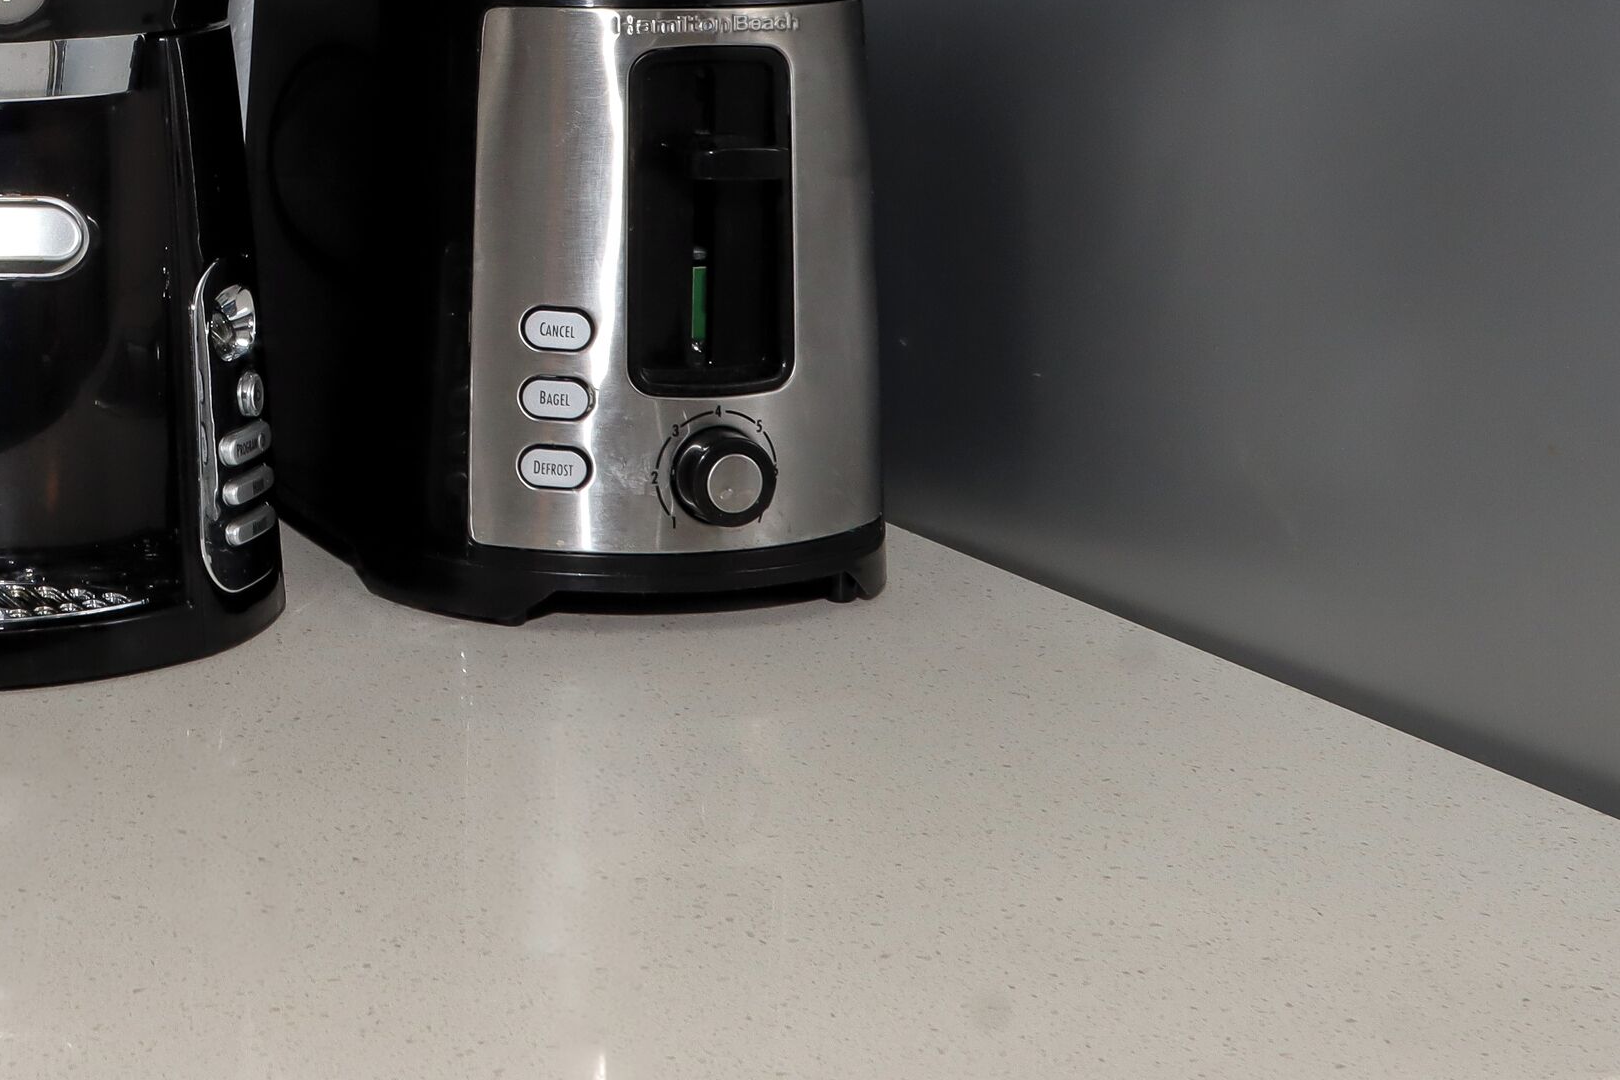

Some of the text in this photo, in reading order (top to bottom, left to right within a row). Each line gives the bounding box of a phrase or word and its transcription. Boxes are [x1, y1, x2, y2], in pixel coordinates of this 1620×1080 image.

[733, 13, 799, 32] Beach
[714, 405, 722, 418] 4
[672, 424, 680, 437] 3
[756, 420, 763, 433] 5
[651, 471, 659, 484] 2
[671, 516, 677, 529] 1
